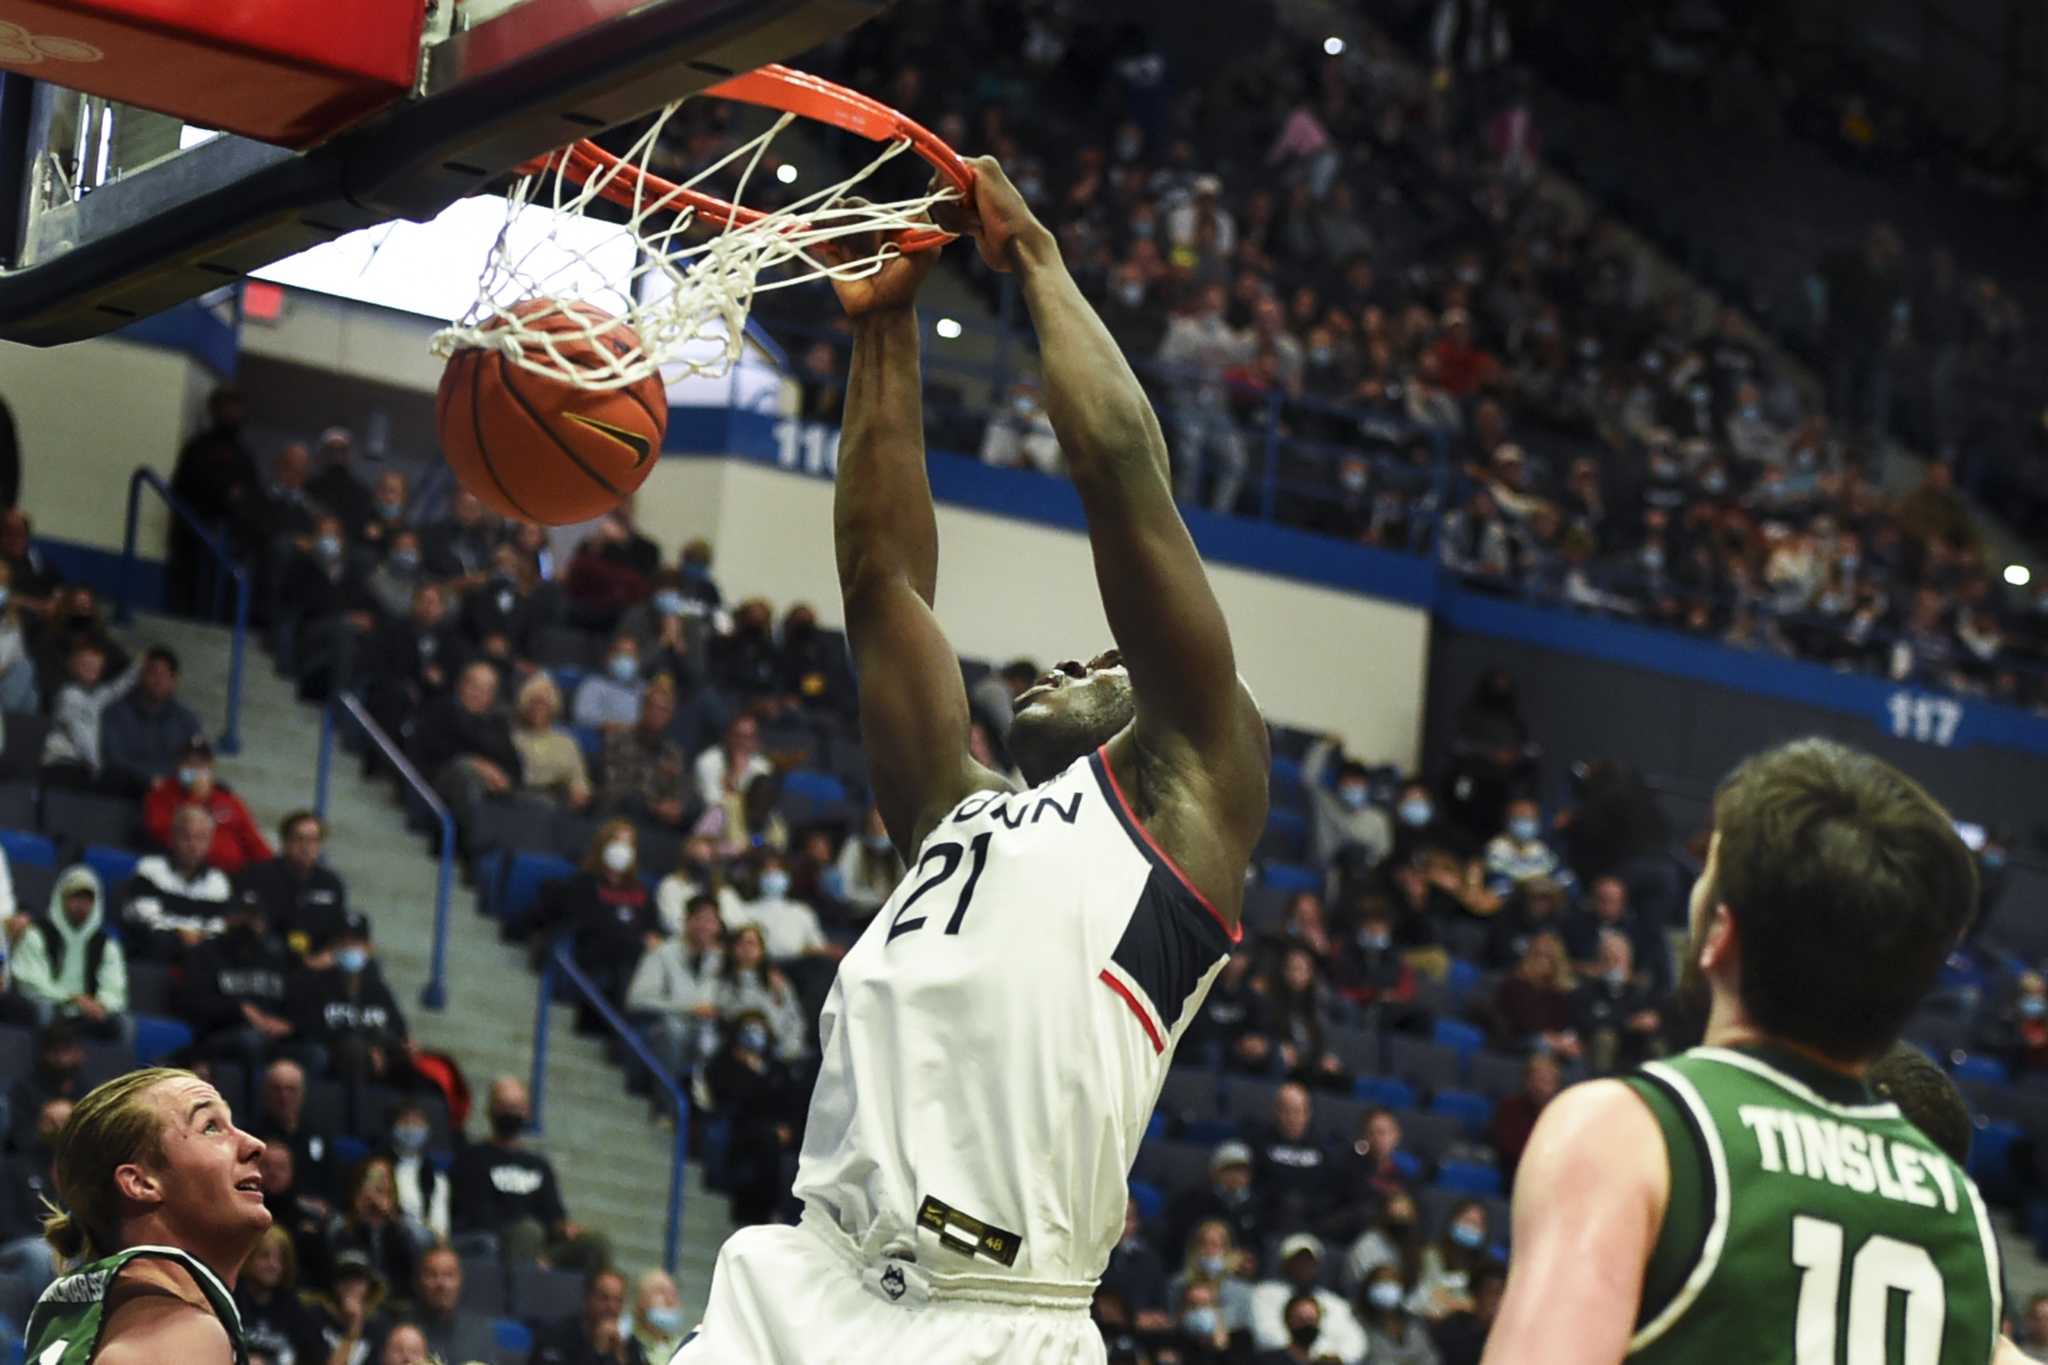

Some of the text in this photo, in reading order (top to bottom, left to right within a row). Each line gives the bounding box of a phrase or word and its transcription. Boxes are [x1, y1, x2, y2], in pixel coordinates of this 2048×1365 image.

[1888, 693, 1962, 747] 117
[886, 832, 993, 946] 21
[1738, 1104, 1958, 1214] TINSLEY
[1793, 1215, 1946, 1365] 10
